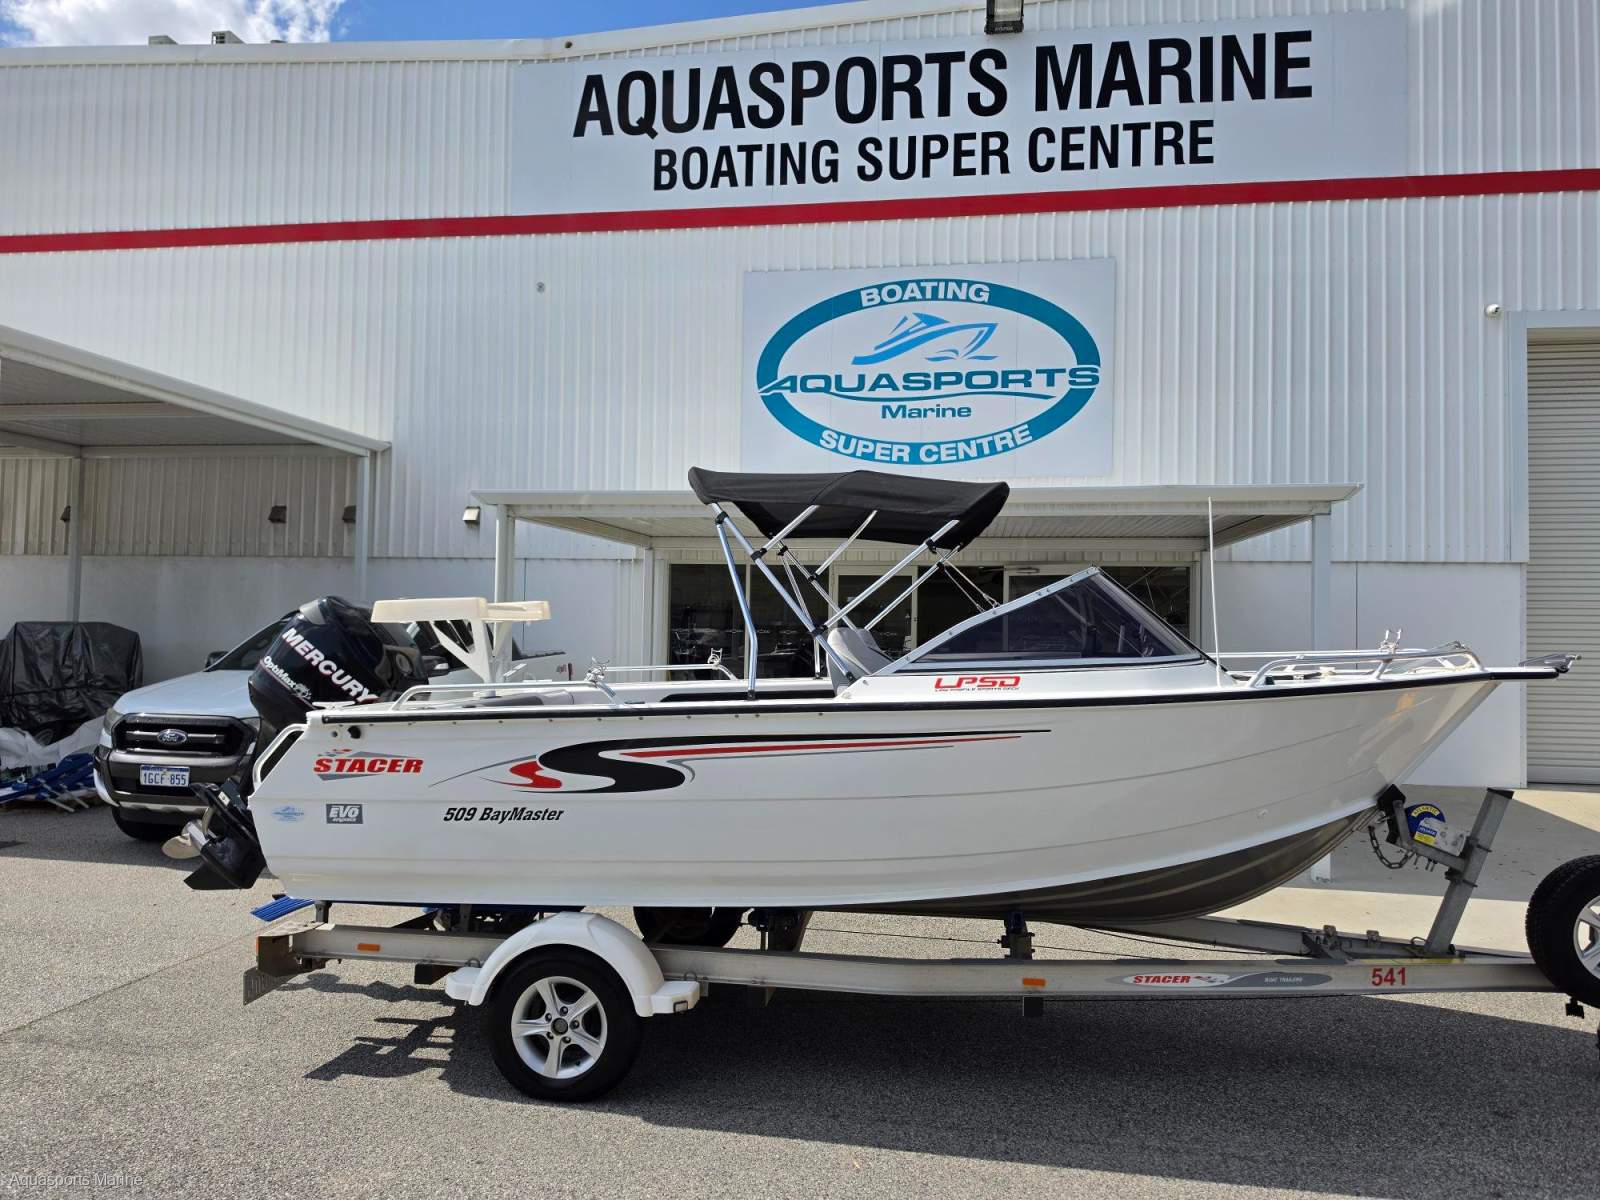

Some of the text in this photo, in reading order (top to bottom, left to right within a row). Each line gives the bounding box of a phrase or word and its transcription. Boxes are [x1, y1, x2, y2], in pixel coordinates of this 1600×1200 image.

[573, 30, 1312, 139] AQUASPORTS MARINE
[653, 119, 1214, 191] BOATING SUPER CENTRE
[860, 281, 990, 307] BOATING
[758, 366, 1101, 394] AQUASPORTS
[881, 404, 972, 419] Marine
[819, 424, 1033, 464] SUPER CENTRE
[282, 627, 377, 702] MERCURY
[313, 758, 425, 773] STACER
[329, 805, 361, 818] EVO
[443, 807, 565, 824] 509 BayMaster
[1132, 975, 1191, 984] STACER
[1371, 967, 1406, 986] 541
